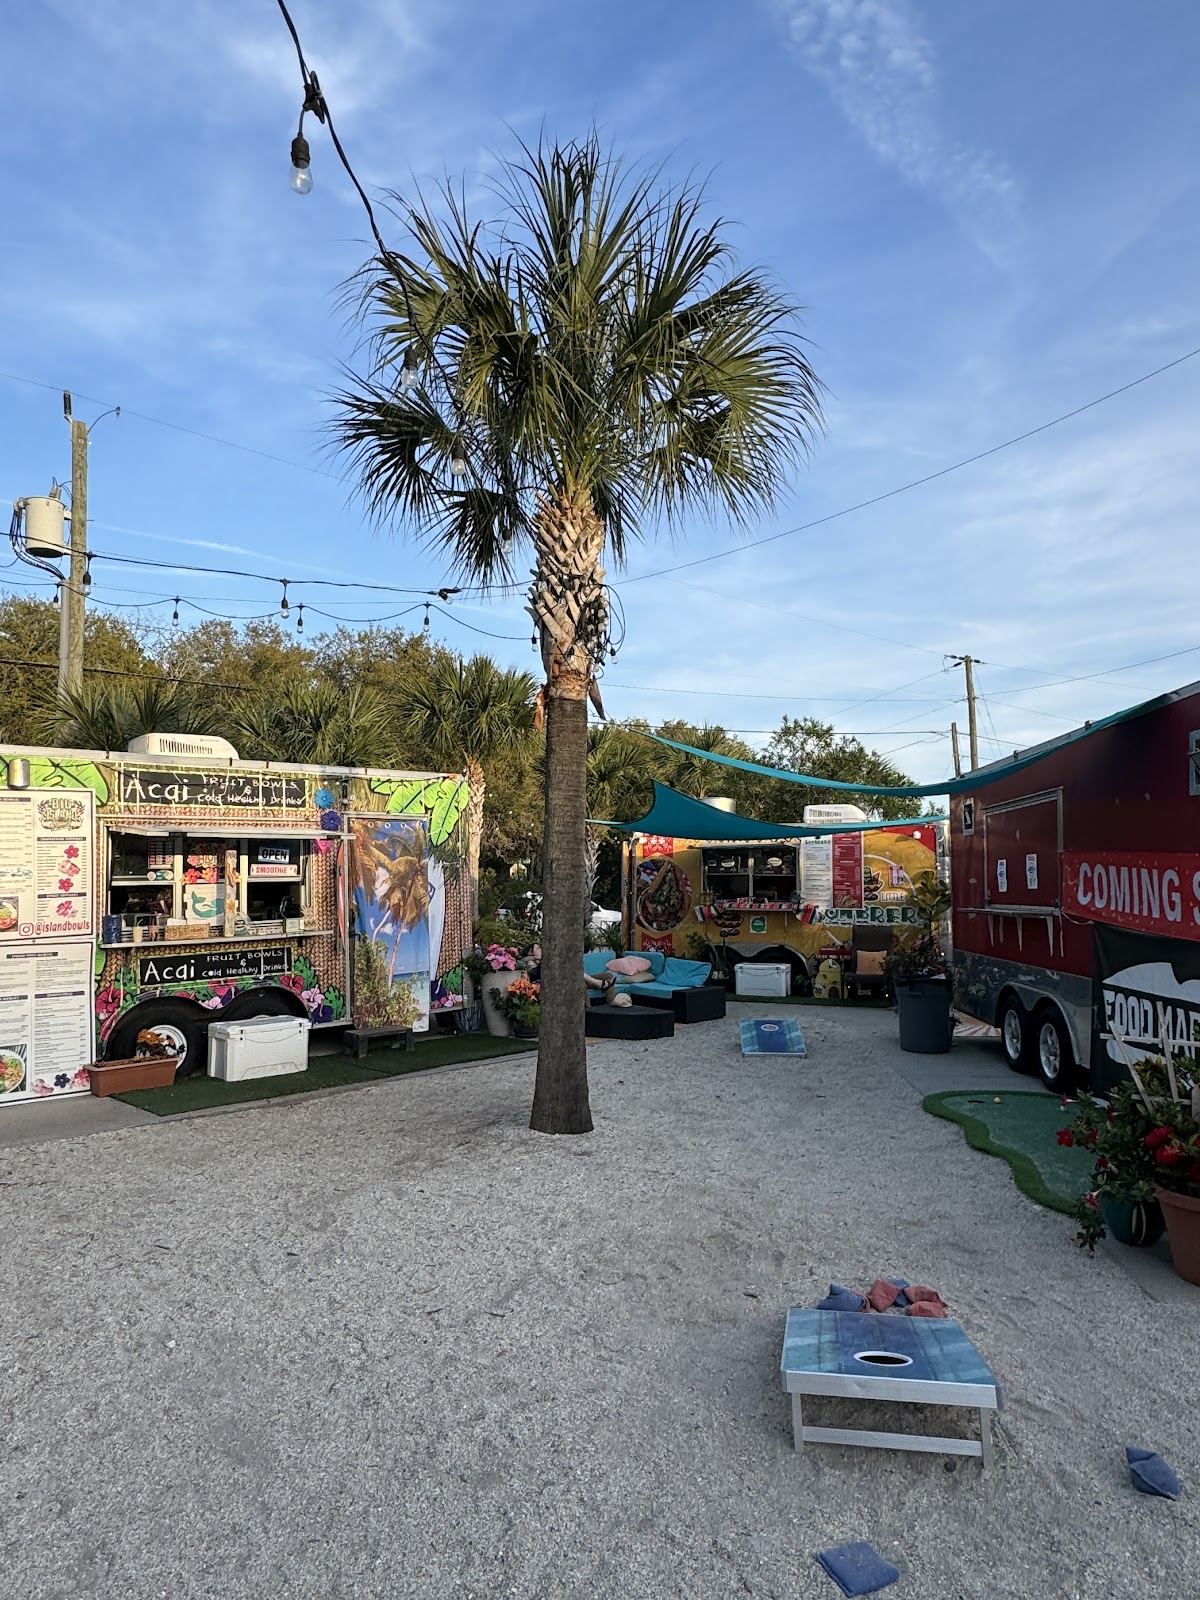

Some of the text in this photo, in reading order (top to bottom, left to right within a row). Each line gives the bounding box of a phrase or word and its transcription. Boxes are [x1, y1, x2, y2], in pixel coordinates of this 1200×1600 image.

[204, 777, 297, 789] FRUIT BOWLS
[51, 798, 72, 809] BIG
[46, 809, 77, 821] ISLAND
[261, 848, 287, 860] OPEN
[882, 892, 906, 901] LITTLE
[1077, 862, 1182, 923] COMING
[823, 905, 922, 923] OMBRER
[35, 920, 90, 935] @islandbowls
[207, 949, 283, 962] FRUIT BOWLS
[240, 958, 247, 967] &
[144, 959, 195, 983] Acai
[226, 966, 259, 976] Healthy
[1103, 989, 1153, 1045] FOOD
